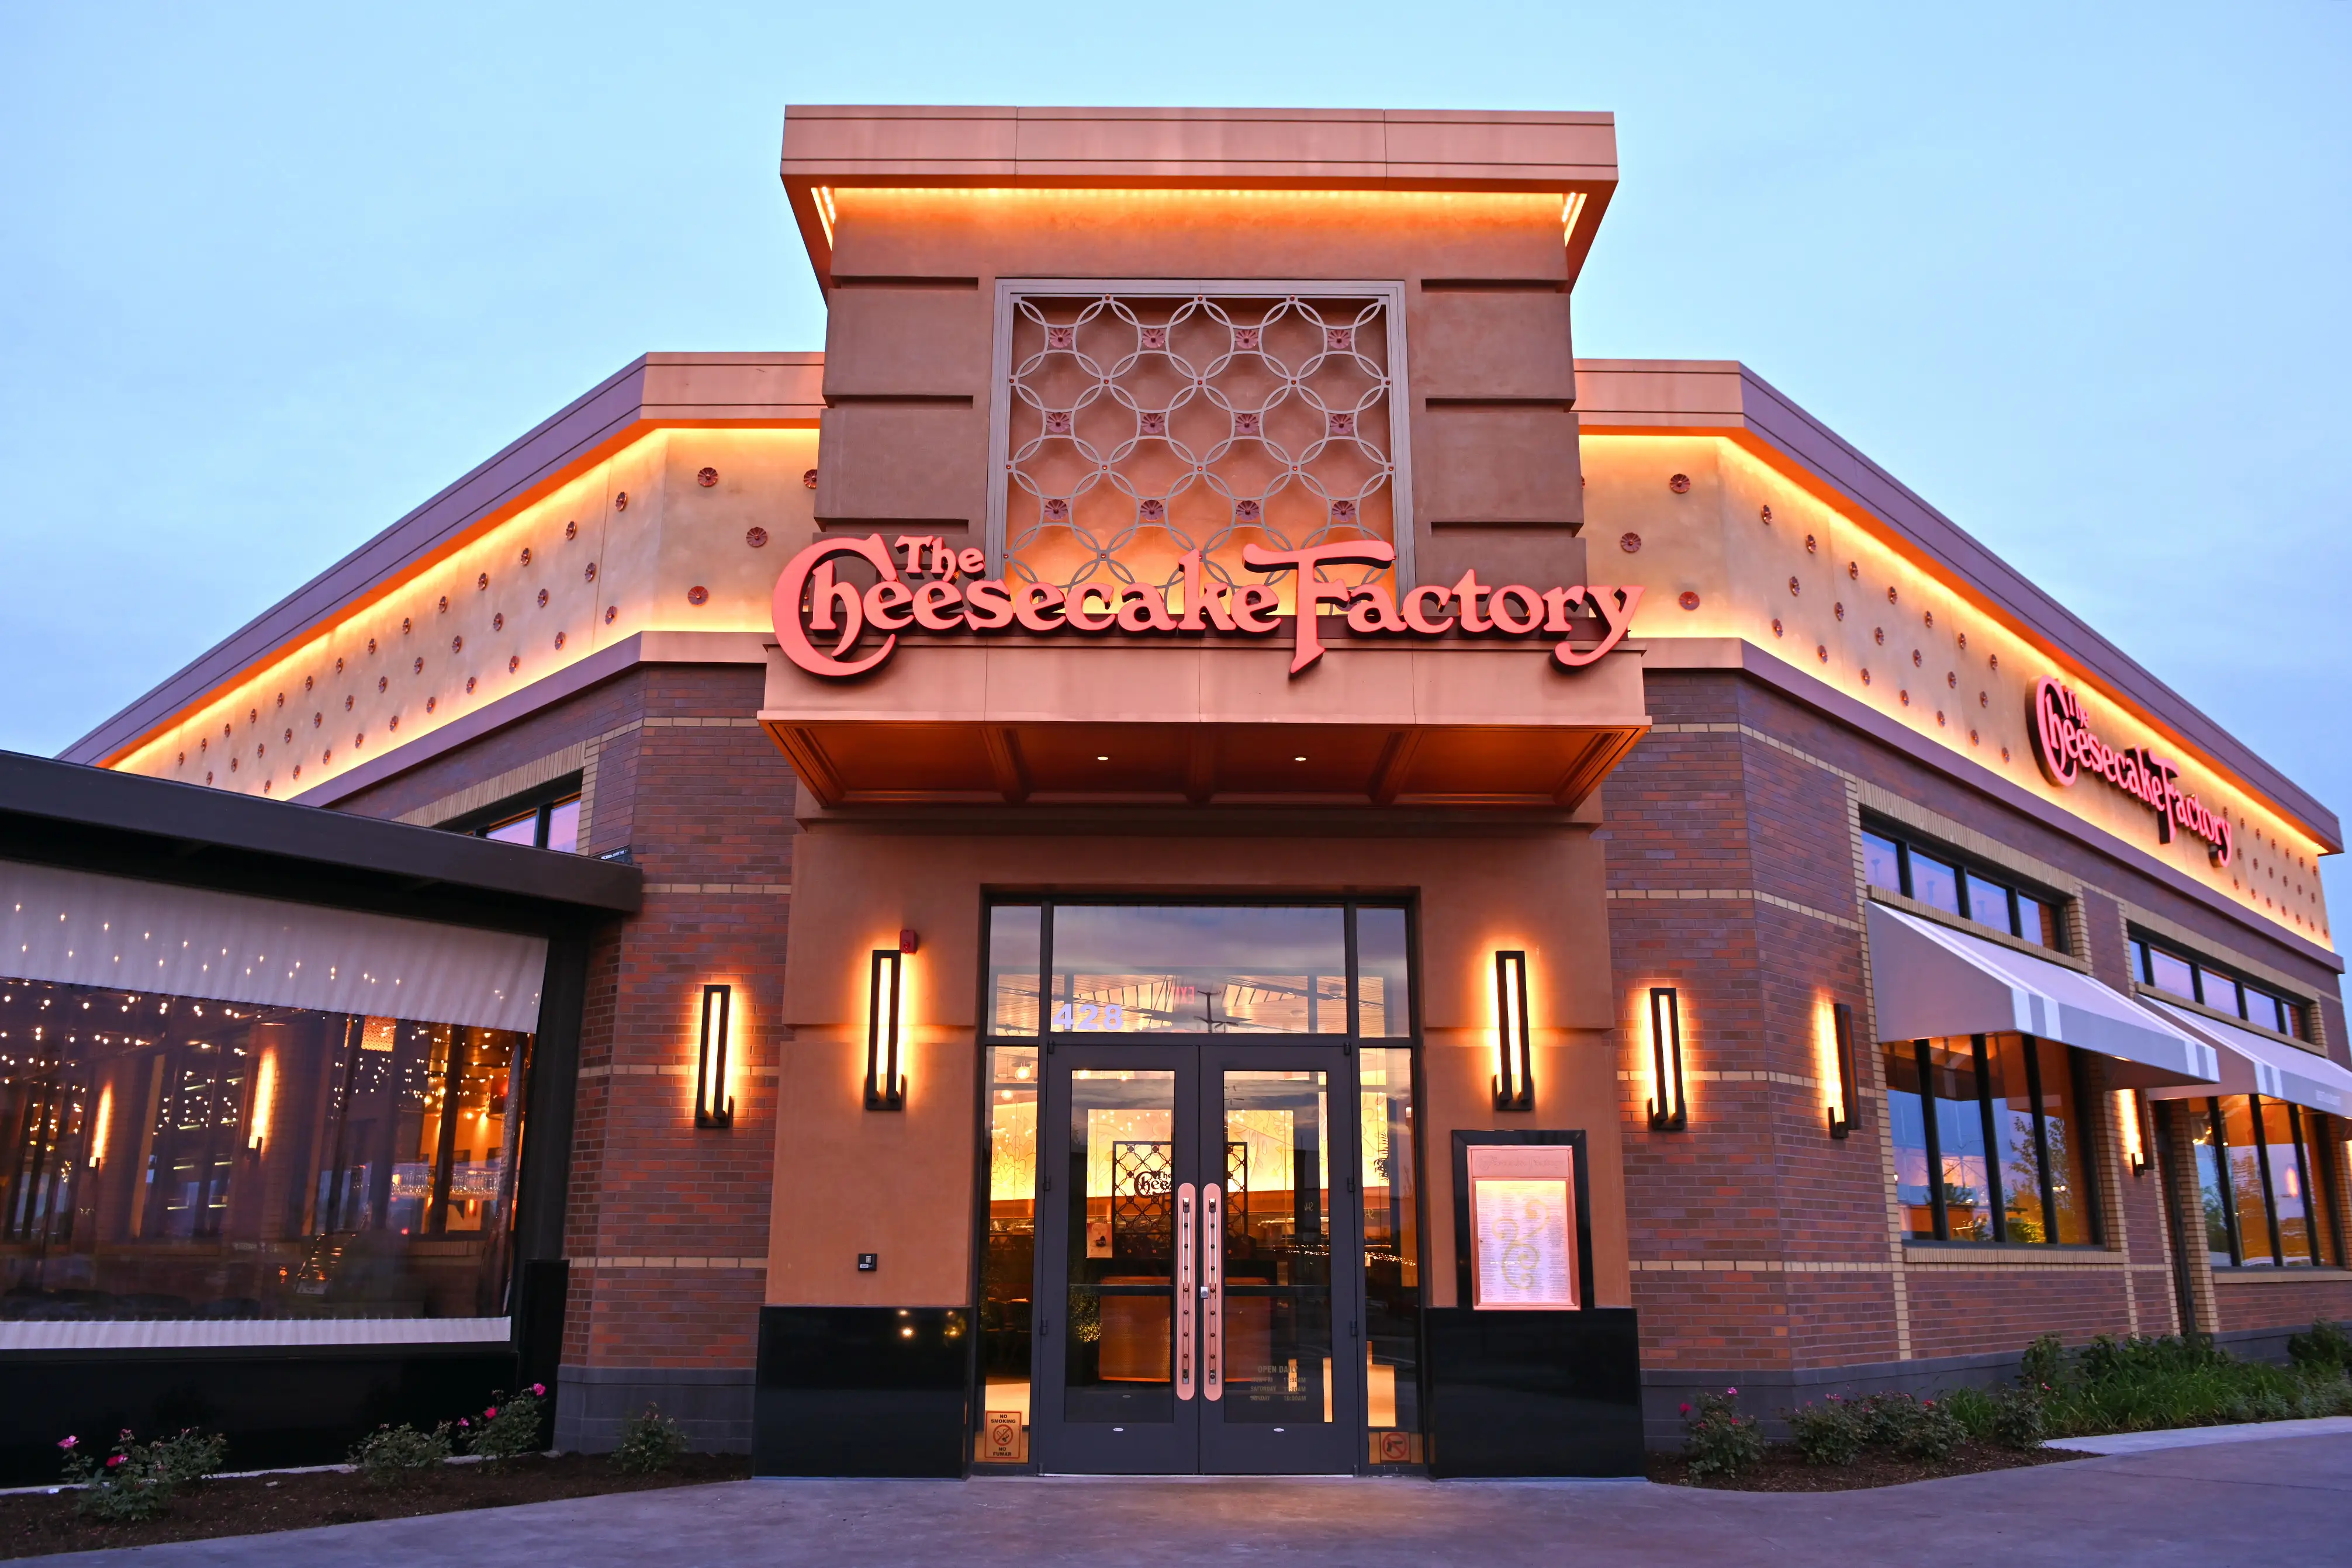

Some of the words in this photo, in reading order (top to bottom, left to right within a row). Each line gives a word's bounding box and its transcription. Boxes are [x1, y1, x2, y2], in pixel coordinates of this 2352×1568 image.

[895, 535, 986, 583] The
[771, 533, 1282, 677] Cheesecake
[1241, 539, 1646, 676] Factory
[2061, 685, 2090, 729] The
[2033, 674, 2165, 812] Cheesecake
[2149, 748, 2232, 867] Factory
[1052, 1003, 1123, 1030] 428
